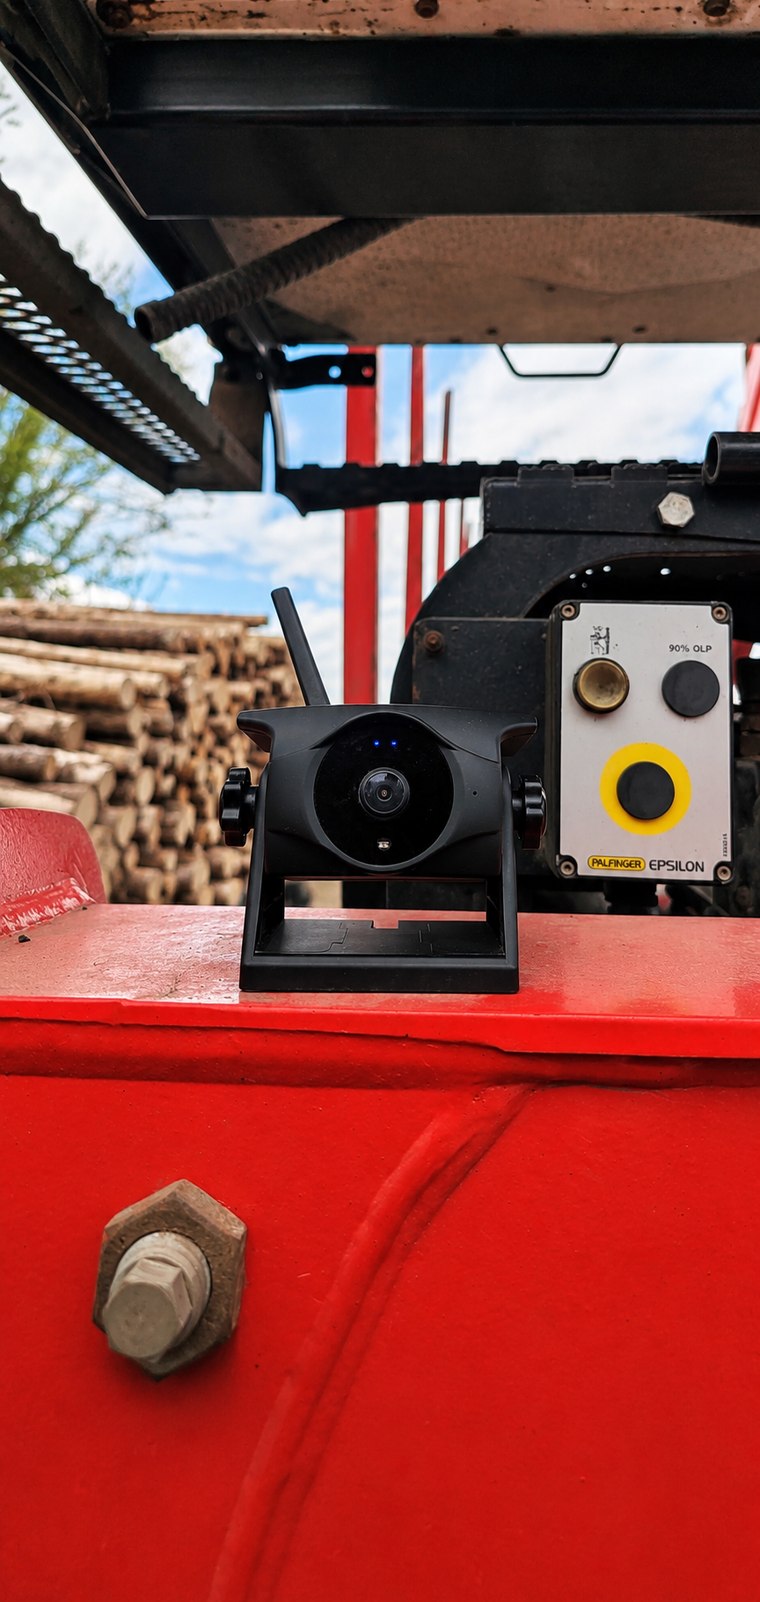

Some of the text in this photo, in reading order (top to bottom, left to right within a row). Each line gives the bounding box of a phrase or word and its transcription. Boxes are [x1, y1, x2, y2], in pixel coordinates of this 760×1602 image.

[668, 644, 713, 653] 90% OLP
[591, 858, 705, 873] PALFINGER EPSILON
